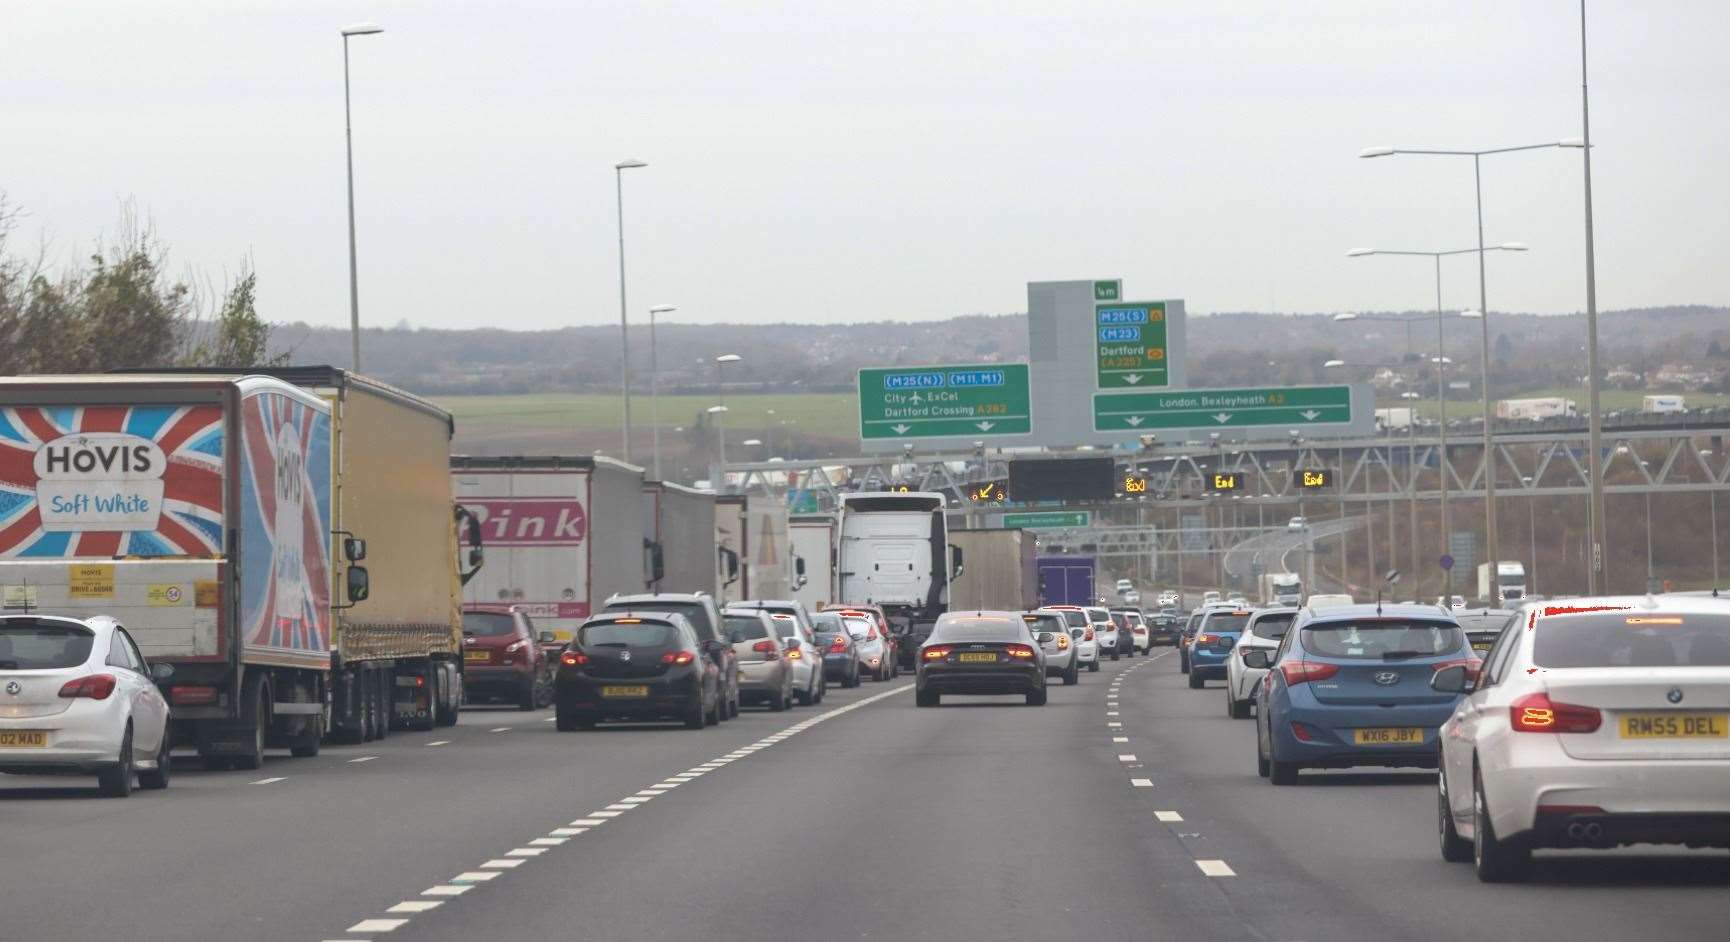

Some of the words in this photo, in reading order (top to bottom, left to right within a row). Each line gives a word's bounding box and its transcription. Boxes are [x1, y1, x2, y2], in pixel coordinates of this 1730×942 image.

[1100, 346, 1144, 356] Dartford
[885, 392, 906, 404] City
[885, 406, 929, 417] Dartford
[931, 405, 975, 417] Crossing
[46, 445, 152, 473] HOVIS
[1215, 475, 1235, 489] End
[1304, 472, 1324, 486] End
[51, 494, 89, 515] Soft
[94, 493, 149, 513] White
[1683, 717, 1721, 736] DEL
[1362, 728, 1389, 741] WX16
[1392, 727, 1416, 741] JBY
